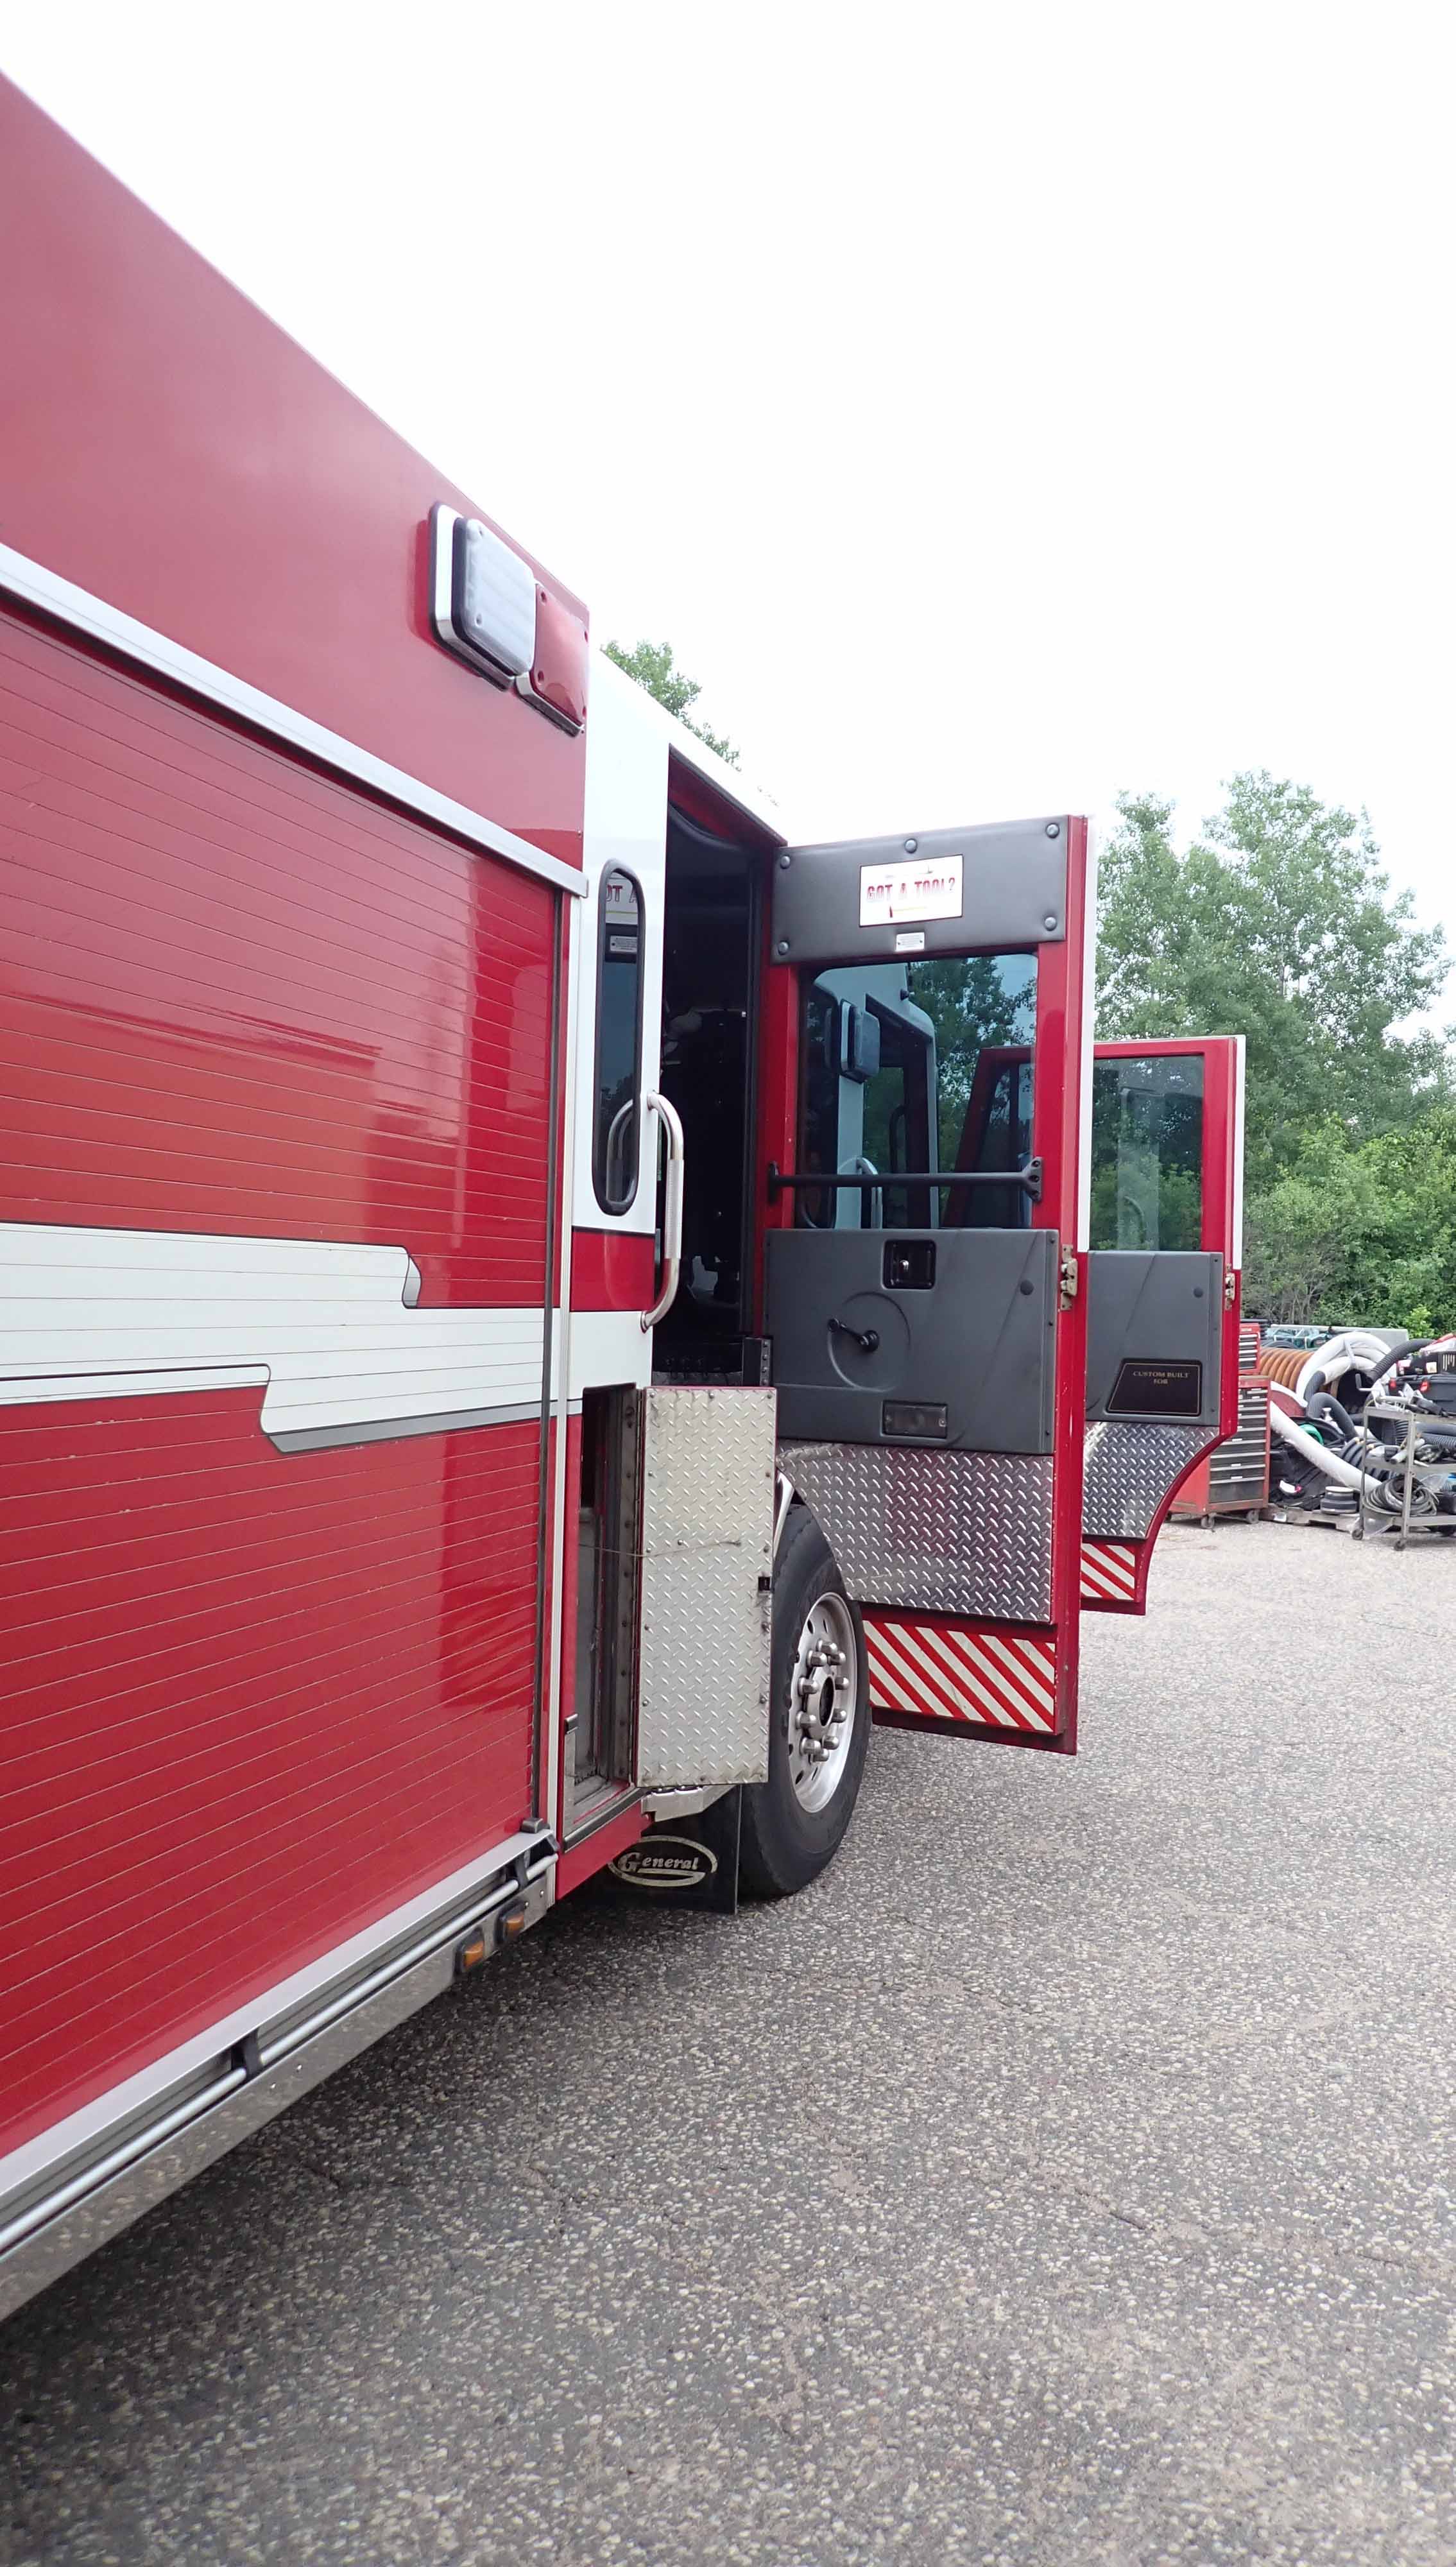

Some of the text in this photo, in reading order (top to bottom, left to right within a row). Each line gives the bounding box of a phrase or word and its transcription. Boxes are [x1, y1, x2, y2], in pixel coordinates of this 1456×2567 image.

[867, 884, 893, 900] GOT
[899, 883, 908, 899] A
[617, 1852, 699, 1872] General
